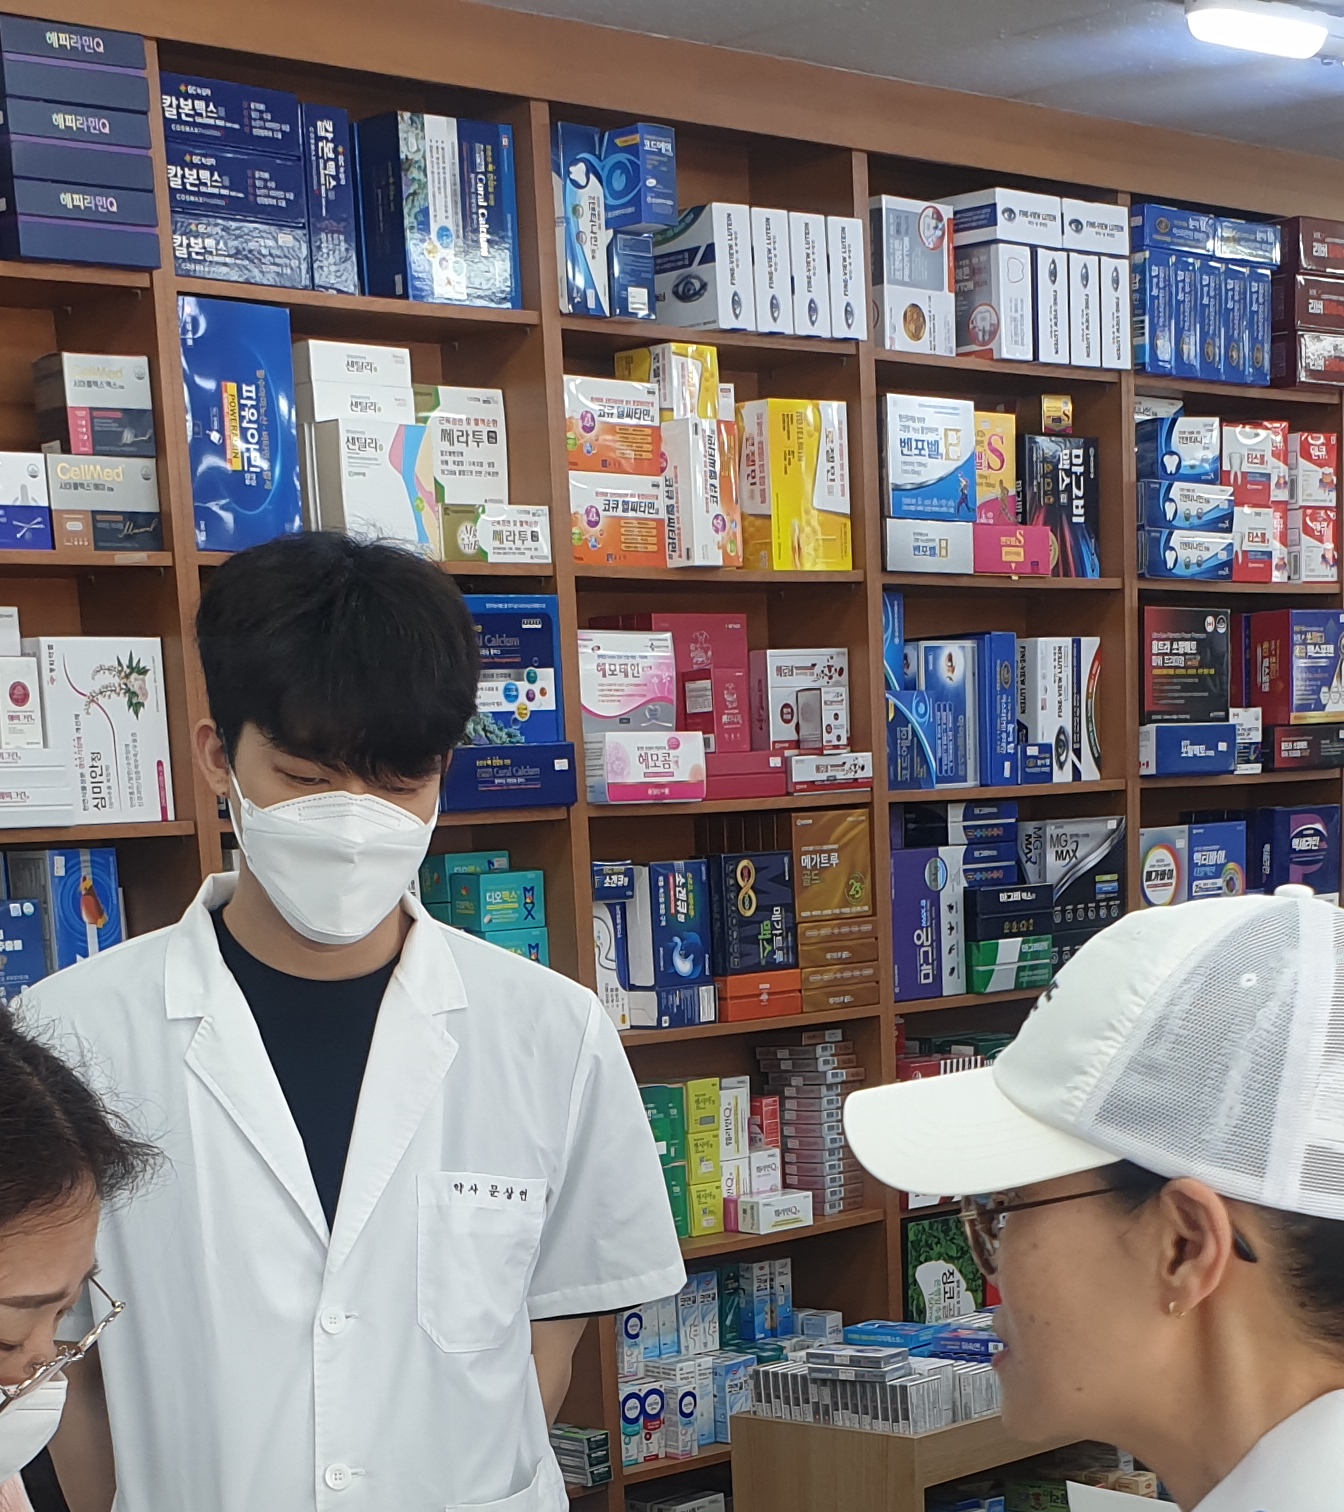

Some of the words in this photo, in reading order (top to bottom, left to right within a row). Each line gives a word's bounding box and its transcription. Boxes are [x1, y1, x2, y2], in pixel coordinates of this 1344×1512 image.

[899, 436, 941, 460] 벤포벨
[57, 461, 125, 483] CellMed
[453, 1182, 480, 1199] 약사
